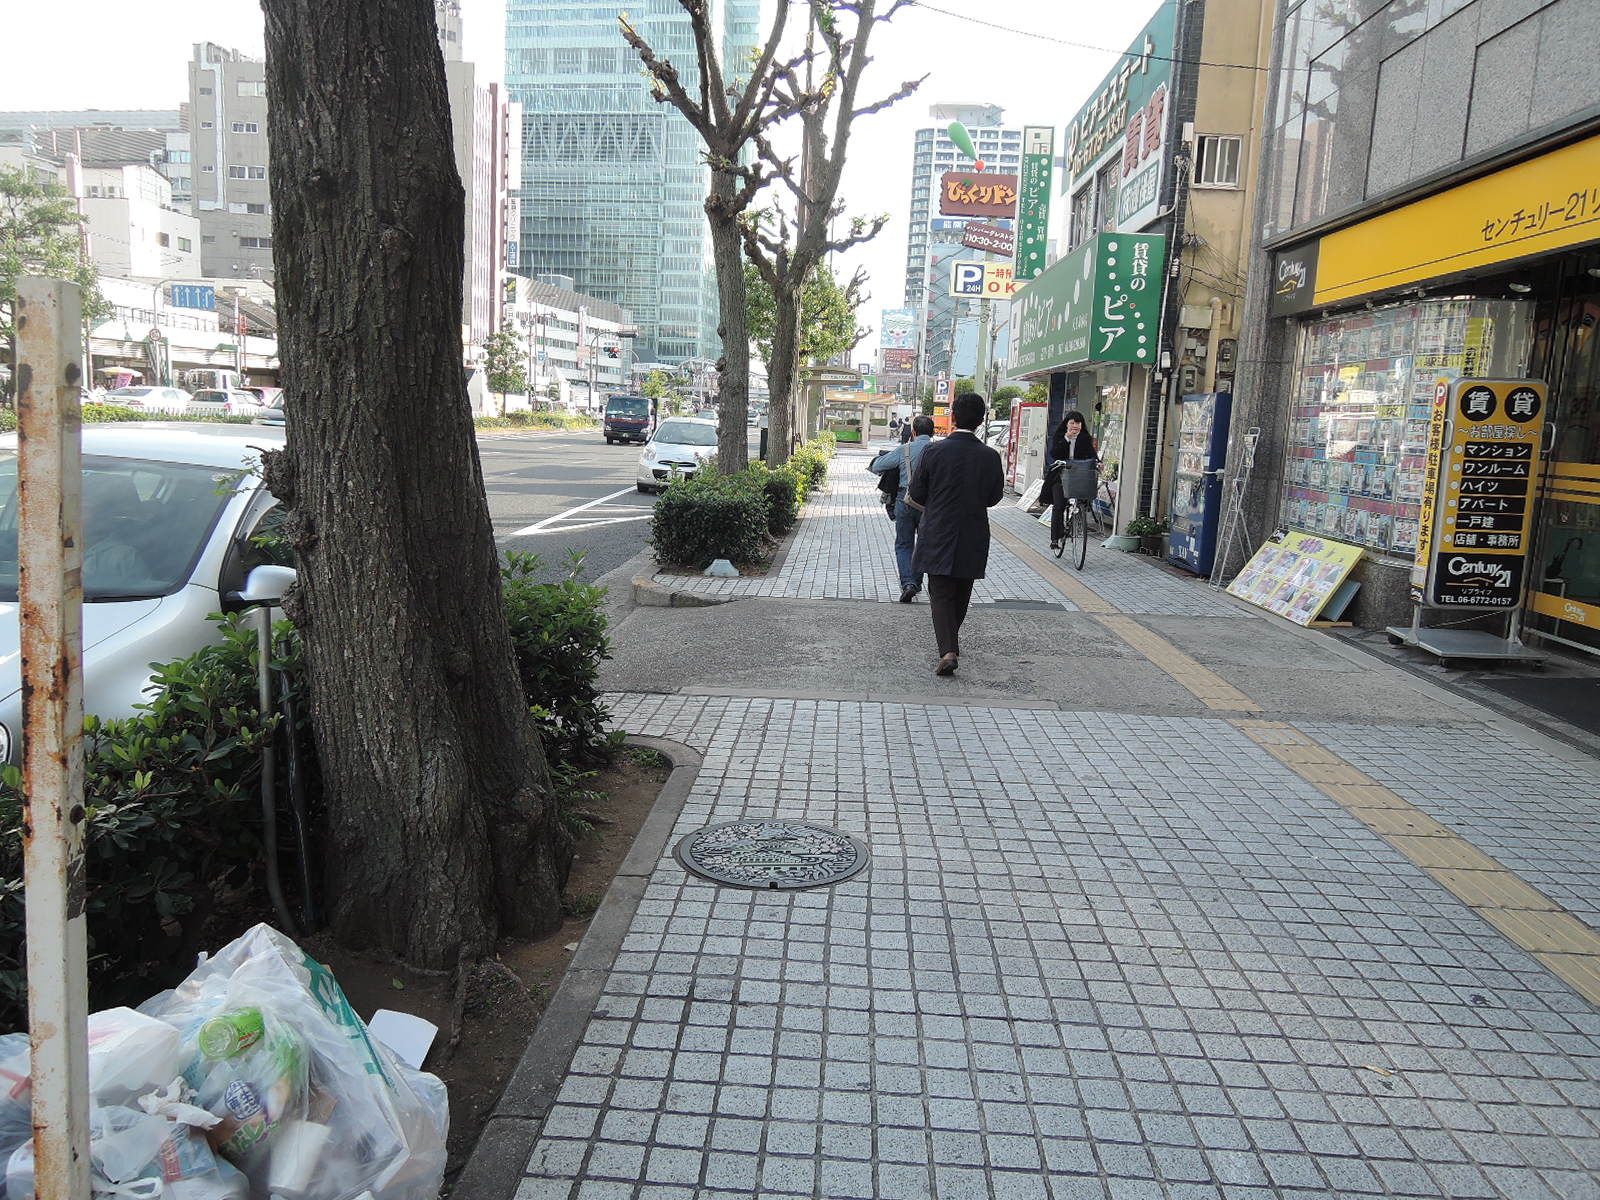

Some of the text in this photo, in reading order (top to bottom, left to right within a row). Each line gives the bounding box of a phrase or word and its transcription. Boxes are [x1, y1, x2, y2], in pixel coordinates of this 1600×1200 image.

[1130, 242, 1149, 291] 賃貸の
[957, 265, 982, 292] P
[966, 284, 981, 292] 24H
[1099, 294, 1128, 354] ピア
[1466, 444, 1528, 457] マンション
[1464, 462, 1525, 475] ワンルーム
[1460, 481, 1499, 493] ハイツ
[1460, 498, 1508, 511] アパート
[1457, 515, 1495, 529] 一戸建
[1448, 556, 1511, 588] Century 21
